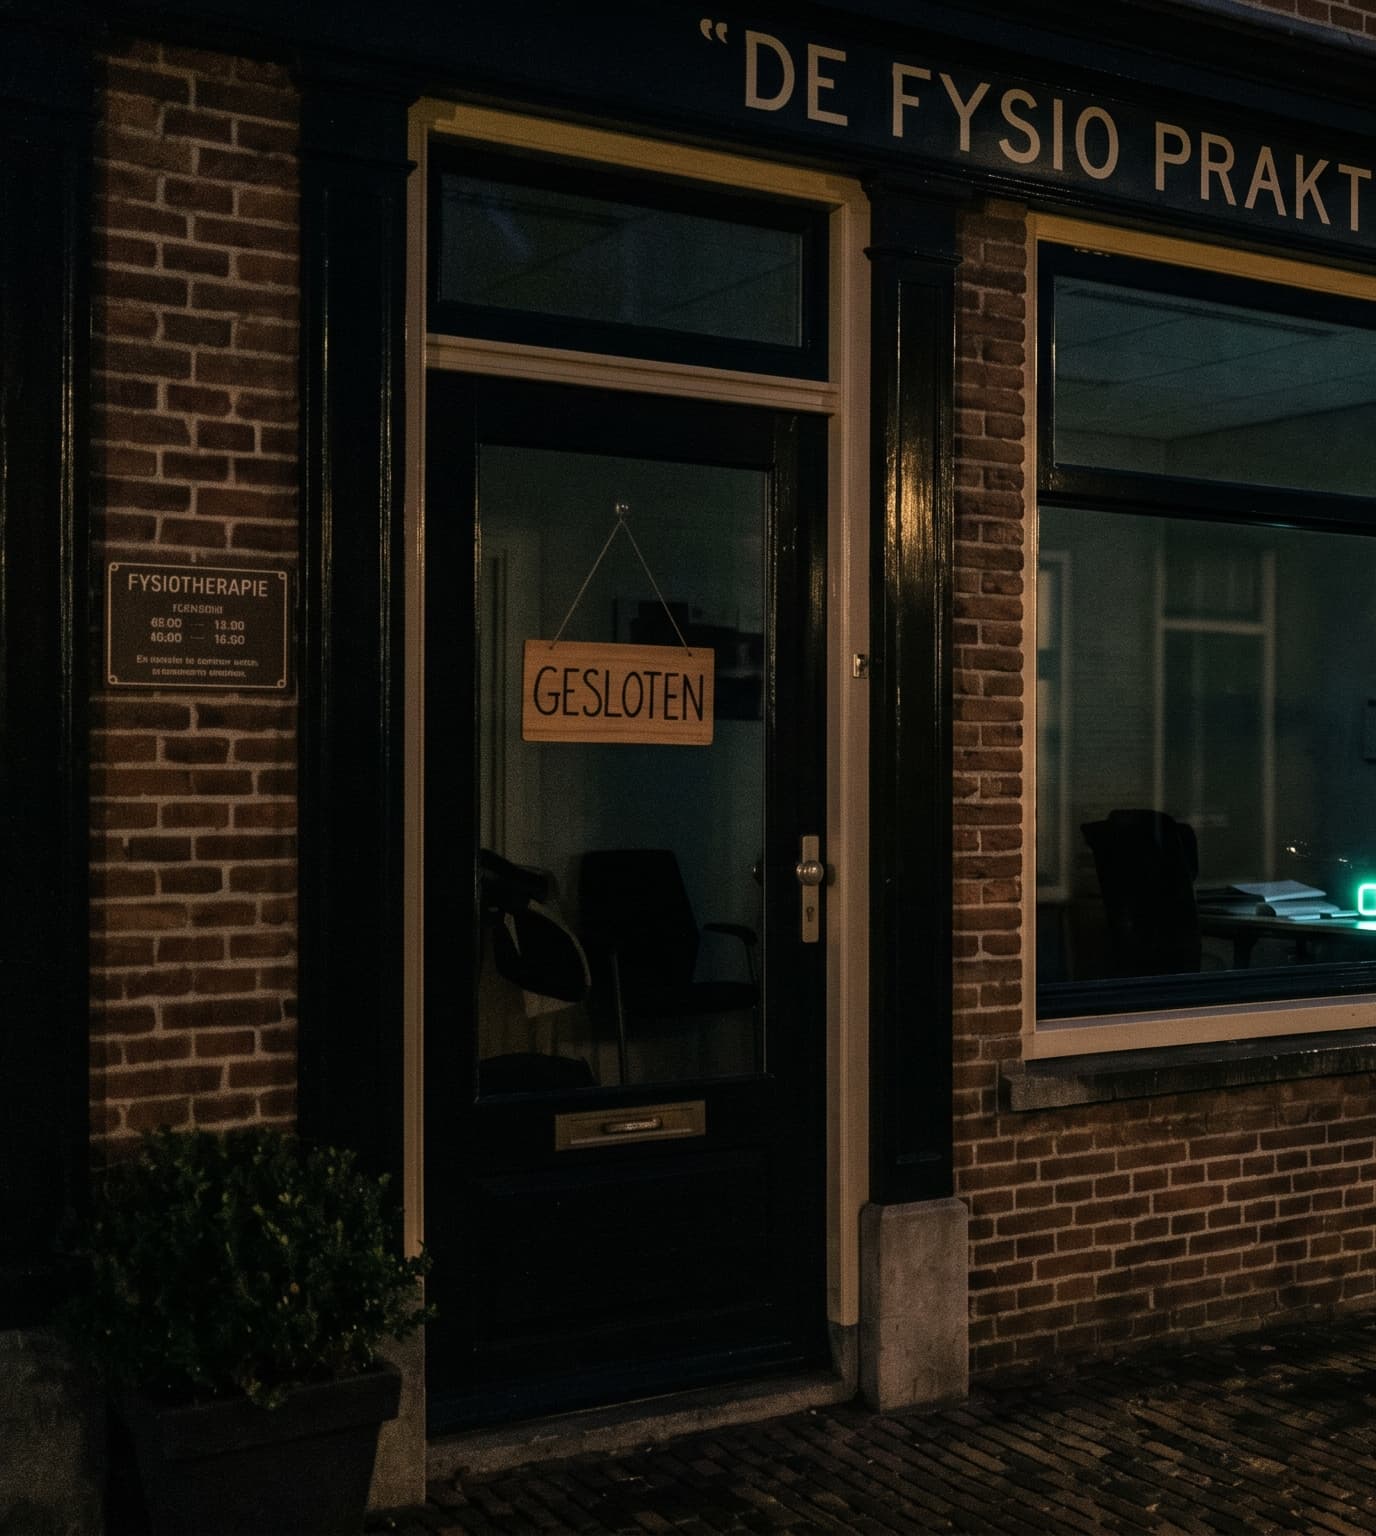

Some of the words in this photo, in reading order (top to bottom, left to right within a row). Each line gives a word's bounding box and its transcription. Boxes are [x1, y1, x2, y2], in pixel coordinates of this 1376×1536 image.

[892, 62, 1119, 180] FYSIO
[127, 573, 269, 597] FYSIOTHERAPIE
[533, 666, 704, 722] GESLOTEN
